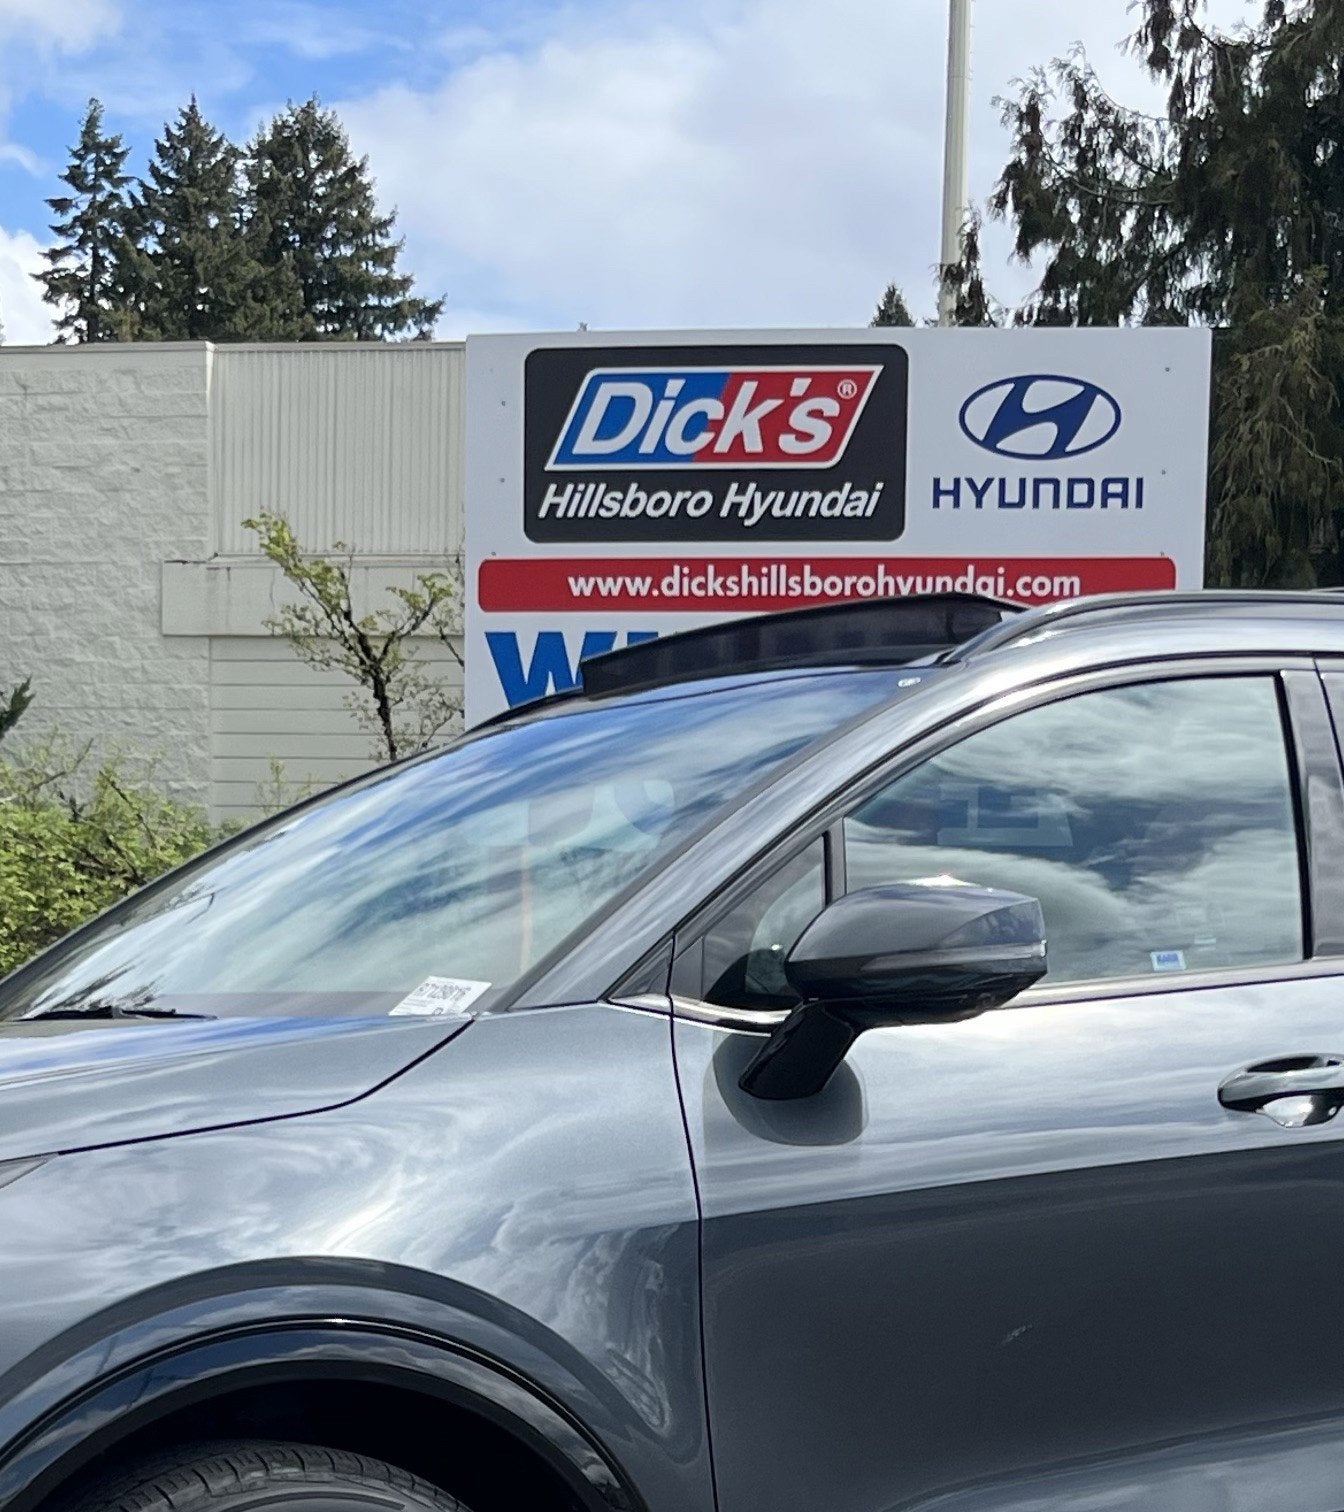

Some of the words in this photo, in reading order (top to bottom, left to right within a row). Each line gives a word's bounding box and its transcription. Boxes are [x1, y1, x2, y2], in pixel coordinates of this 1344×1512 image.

[572, 377, 840, 456] Dick's
[538, 484, 715, 519] Hillsboro
[721, 482, 884, 527] Hyundai
[932, 476, 1144, 510] HYUNDAI
[567, 563, 1081, 598] www.dickshillsborohyundai.com
